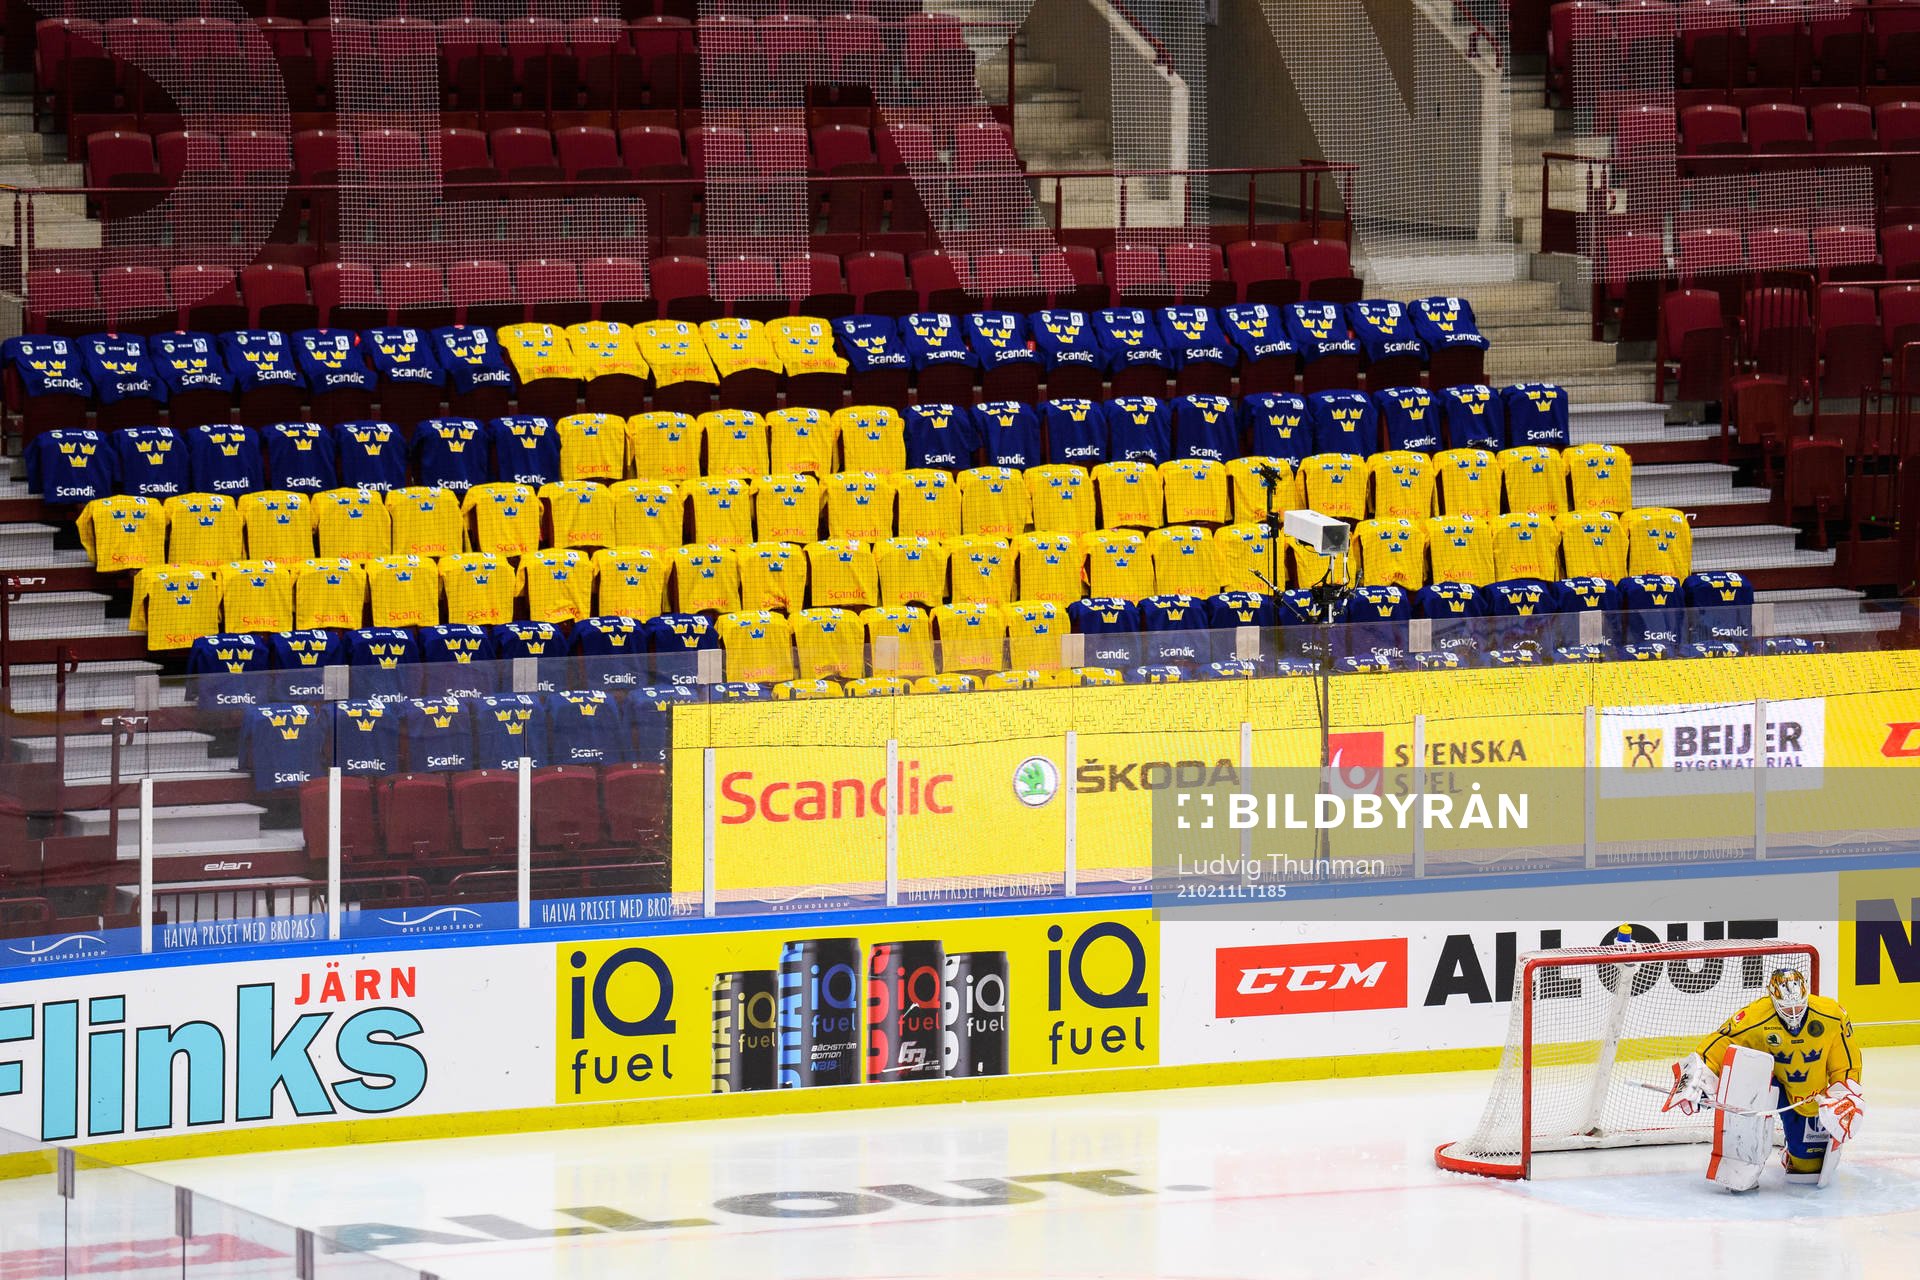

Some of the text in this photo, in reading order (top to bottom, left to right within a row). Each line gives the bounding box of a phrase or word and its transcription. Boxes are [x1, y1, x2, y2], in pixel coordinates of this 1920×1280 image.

[1254, 340, 1292, 355] Scandic
[1318, 340, 1356, 352] Scandic
[1384, 340, 1421, 353] Scandic
[868, 353, 906, 364] Scandic
[995, 349, 1033, 361] Scandic
[1056, 351, 1094, 363] Scandic
[1127, 349, 1163, 360] Scandic
[1187, 348, 1223, 360] Scandic
[182, 373, 222, 386] Scandic
[257, 368, 297, 381] Scandic
[326, 372, 365, 385] Scandic
[392, 367, 433, 379] Scandic
[472, 371, 511, 383] Scandic
[44, 377, 84, 391] Scandic
[214, 477, 249, 491] Scandi
[1711, 626, 1748, 637] Scandic
[1096, 649, 1130, 661] candic
[672, 674, 699, 685] Scan
[289, 685, 324, 696] Scand
[217, 693, 257, 705] Scandic
[1395, 739, 1527, 767] SENSKA
[501, 759, 537, 770] Scac
[1674, 756, 1803, 773] BYGGMATRIAL
[1076, 758, 1240, 794] ŠKODA
[1395, 771, 1463, 798] SEL
[720, 760, 954, 825] Scandic
[204, 861, 252, 871] elan
[542, 896, 693, 923] HALVA PRISET MED BROPASS
[164, 918, 316, 948] HALVA PRISET MED BROPASS
[1047, 921, 1149, 1011] iQ
[294, 961, 417, 1006] JÄRN
[1236, 961, 1388, 996] CCM
[570, 947, 676, 1039] iQ
[810, 963, 857, 1011] iQ
[897, 965, 941, 1011] iQ
[966, 973, 1005, 1013] iQ
[737, 991, 776, 1030] iQ
[811, 1013, 856, 1038] fuel
[897, 1012, 941, 1037] fuel
[967, 1016, 1005, 1037] fuel
[738, 1031, 775, 1053] fuel
[1047, 1016, 1145, 1065] fuel
[571, 1044, 673, 1094] fuel
